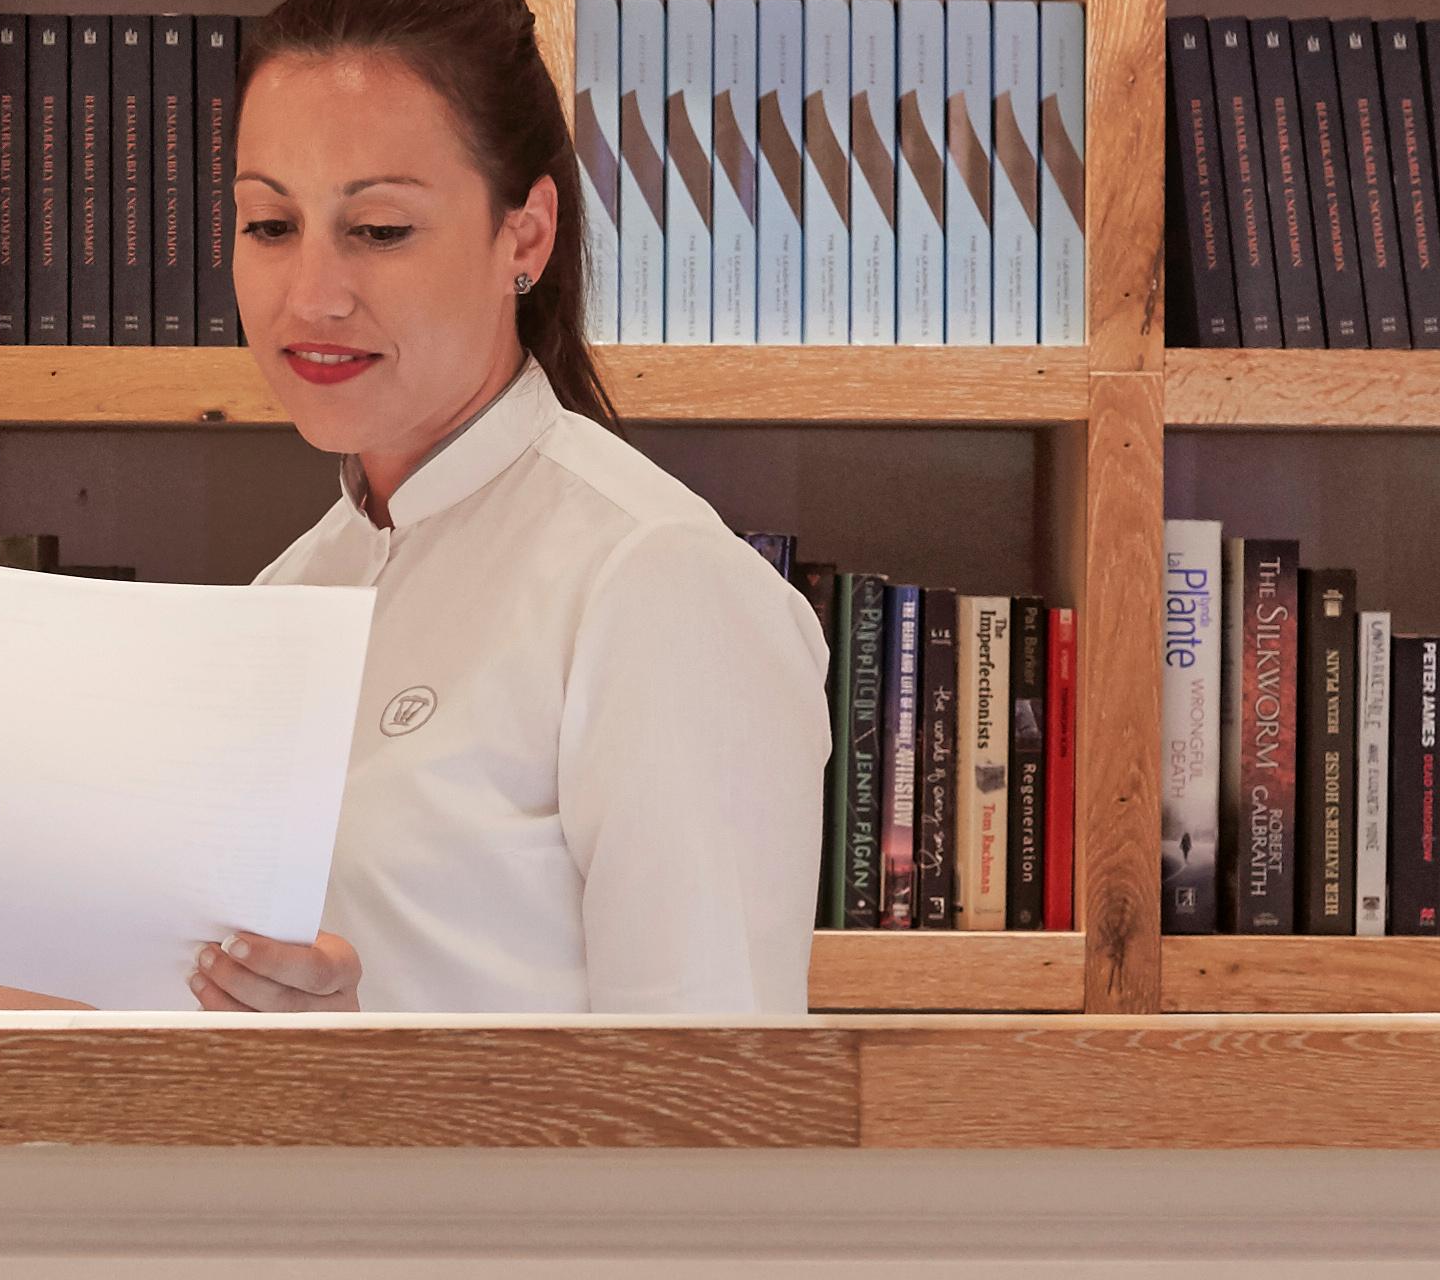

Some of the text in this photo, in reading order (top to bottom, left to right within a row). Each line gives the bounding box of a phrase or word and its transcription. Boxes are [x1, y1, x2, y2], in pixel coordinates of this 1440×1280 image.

[993, 618, 1008, 639] The
[1023, 607, 1038, 687] Pat Barker
[1165, 551, 1208, 669] La Plante
[1255, 556, 1289, 769] THE SILKWORM
[854, 607, 884, 722] PANOPTICON
[977, 610, 996, 749] Imperfectionists
[1421, 641, 1437, 748] PETER JAMES
[933, 719, 951, 762] words
[1171, 740, 1187, 800] DEATH
[1190, 678, 1207, 782] WRONGFUL
[1325, 649, 1340, 916] HER FATHER'S HOUSE BELVA PLAIN
[852, 751, 871, 888] JENNI FAGAN
[893, 750, 913, 826] WINSLOW
[1019, 763, 1037, 882] Regeneration
[1249, 785, 1268, 897] GALBRAITH
[1267, 807, 1283, 875] ROBERT
[1423, 753, 1435, 862] DEAD TOMORROW
[980, 803, 996, 895] Tom Rachman
